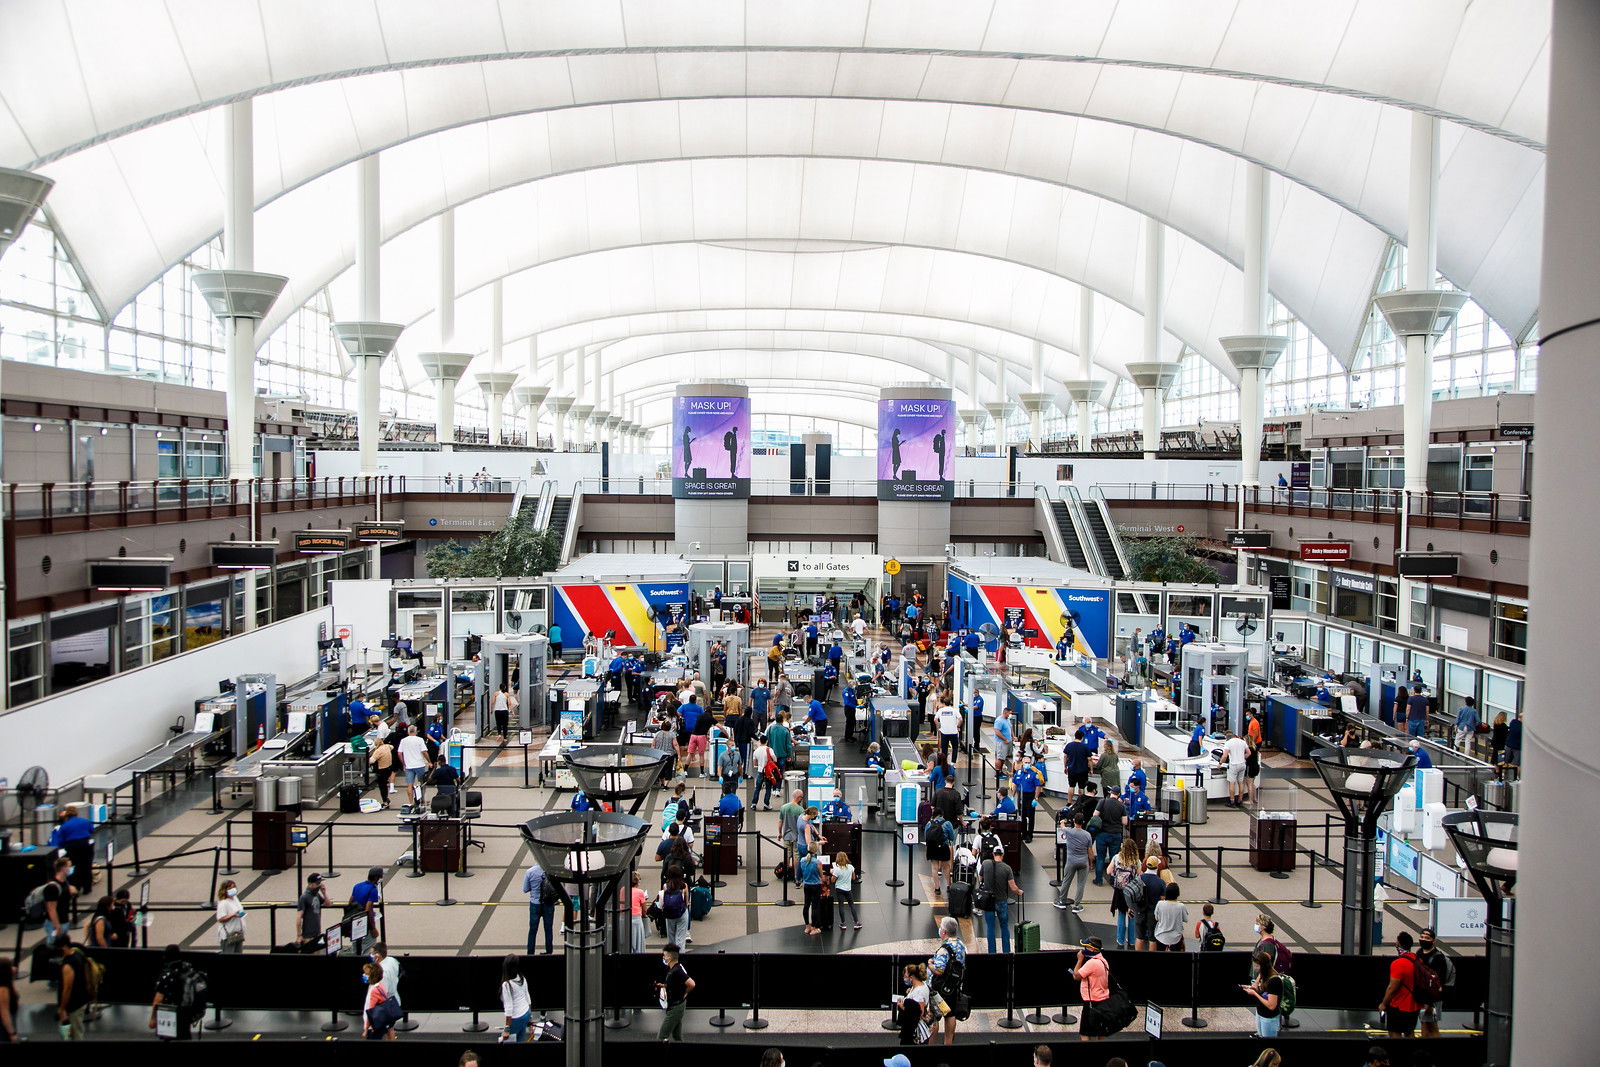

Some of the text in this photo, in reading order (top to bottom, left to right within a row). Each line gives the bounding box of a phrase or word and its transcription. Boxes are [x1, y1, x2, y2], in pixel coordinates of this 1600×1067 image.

[690, 401, 715, 410] MASK
[716, 402, 732, 410] UP!
[900, 404, 926, 412] MASK
[926, 404, 940, 412] UP!
[1120, 523, 1152, 532] Terminal
[813, 562, 824, 570] all
[826, 562, 850, 571] Gates
